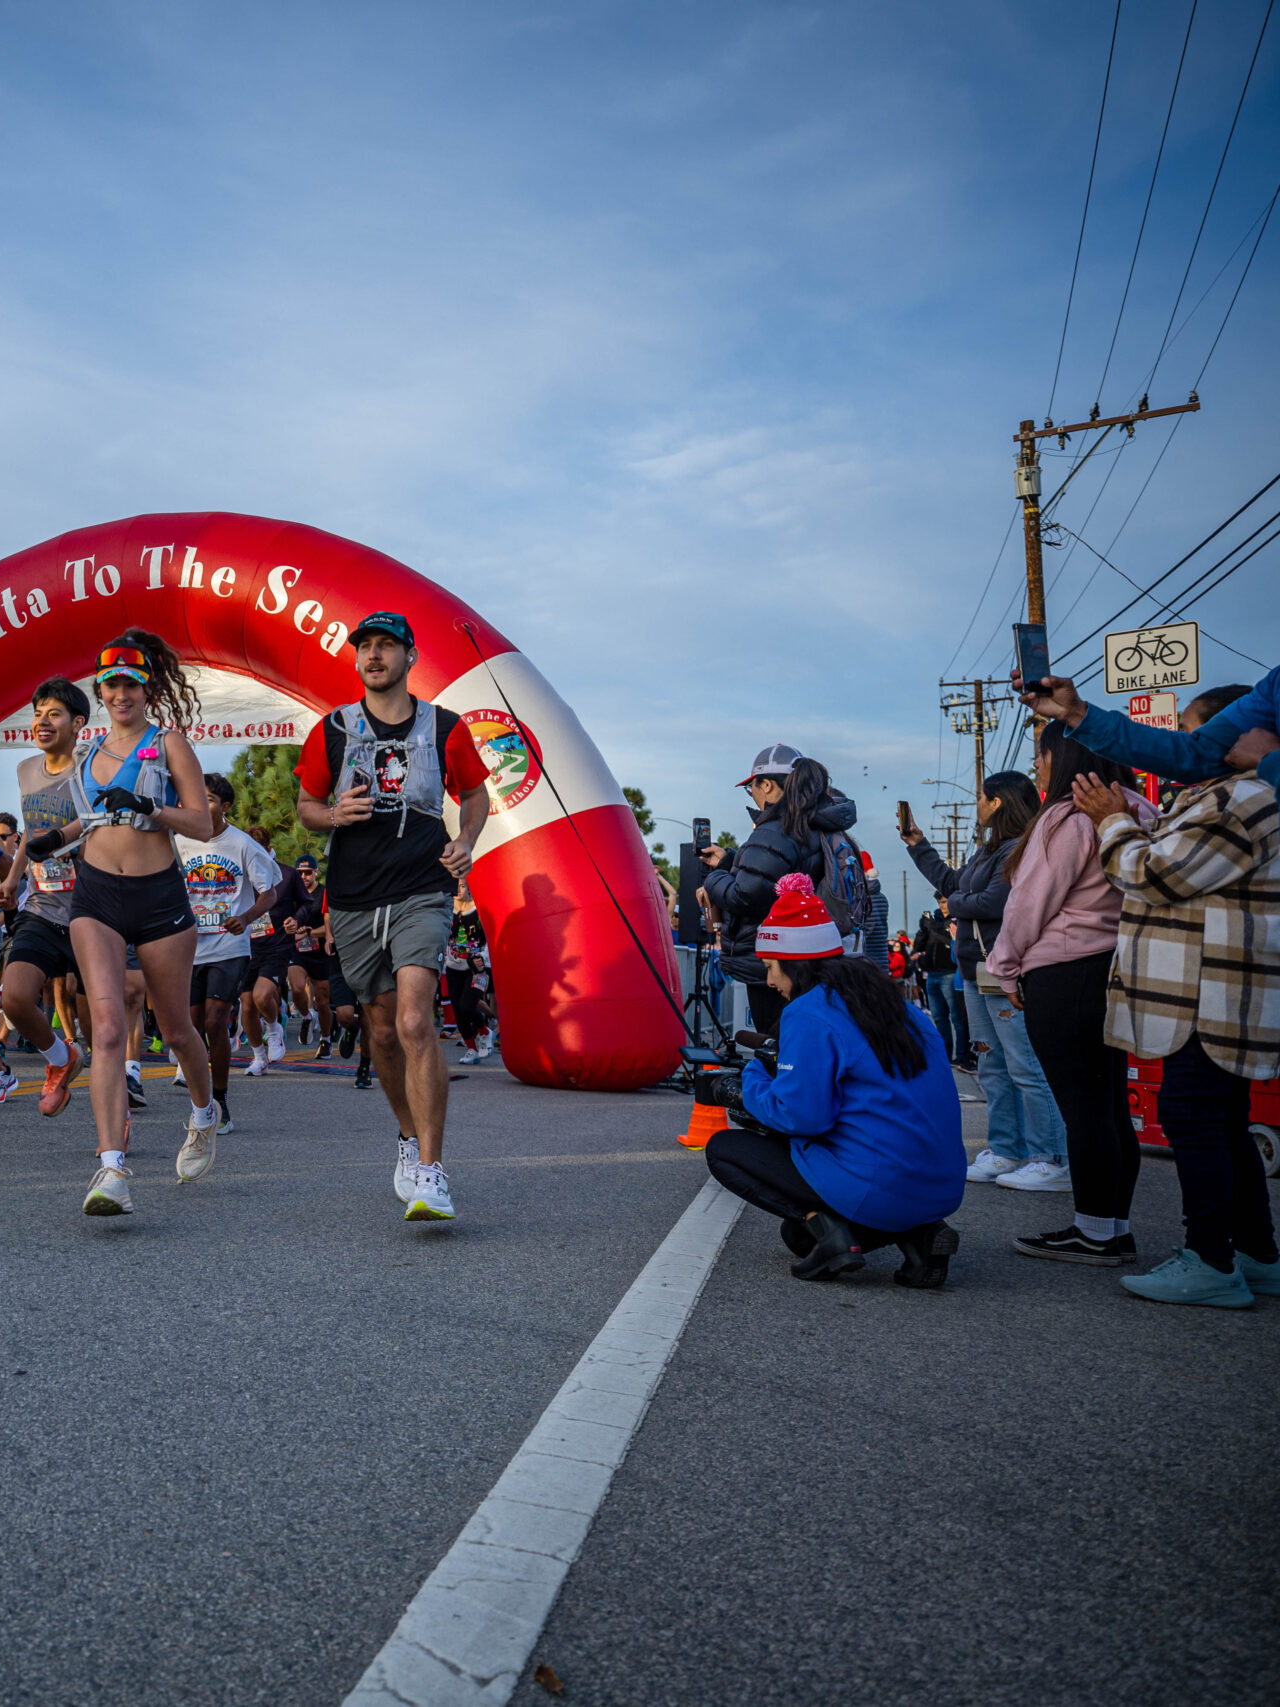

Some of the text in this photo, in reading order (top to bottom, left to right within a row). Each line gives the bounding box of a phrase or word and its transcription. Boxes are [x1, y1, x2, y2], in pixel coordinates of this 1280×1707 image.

[64, 554, 121, 602] To
[140, 543, 236, 598] The
[255, 565, 349, 657] Sea
[1117, 670, 1187, 689] BIKE LANE
[1131, 697, 1148, 713] NO
[478, 710, 500, 722] The
[185, 854, 243, 877] ROSS COUNTRY
[199, 913, 220, 926] 500
